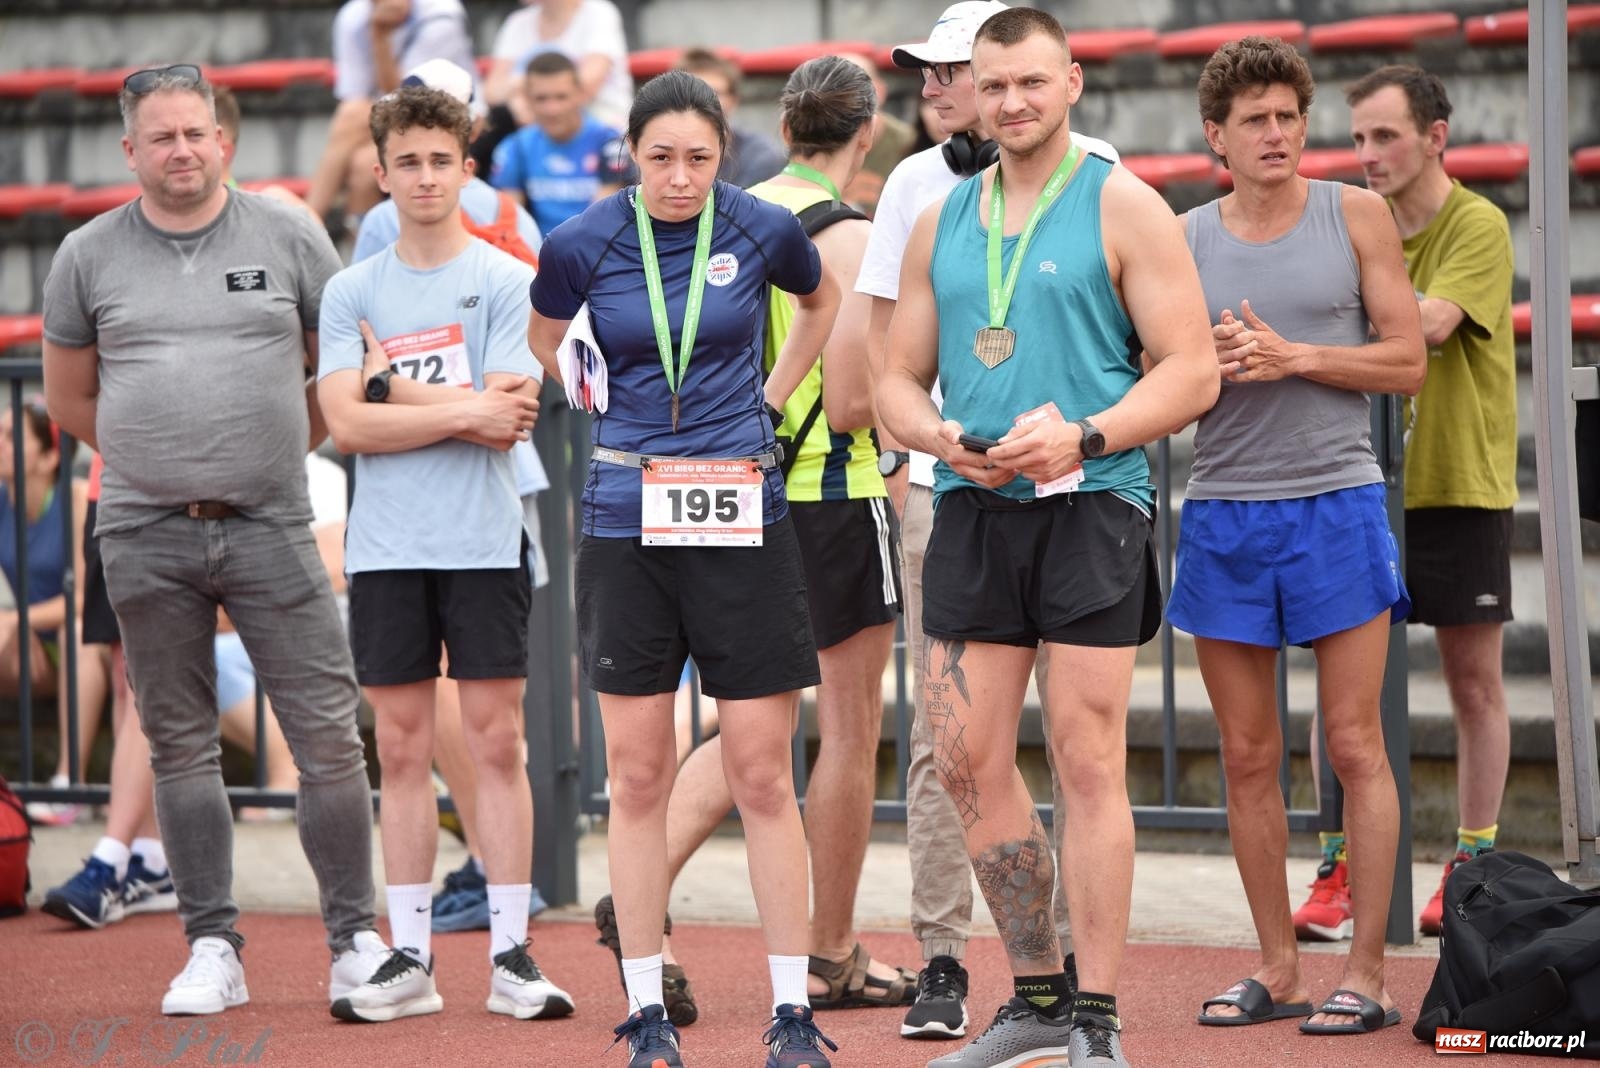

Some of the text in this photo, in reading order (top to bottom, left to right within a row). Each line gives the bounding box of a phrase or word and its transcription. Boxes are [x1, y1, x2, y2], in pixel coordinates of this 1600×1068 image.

[675, 465, 695, 473] BIEG
[696, 465, 712, 473] BEZ
[713, 464, 747, 473] GRANIC
[667, 488, 739, 523] 195
[933, 691, 942, 701] TE
